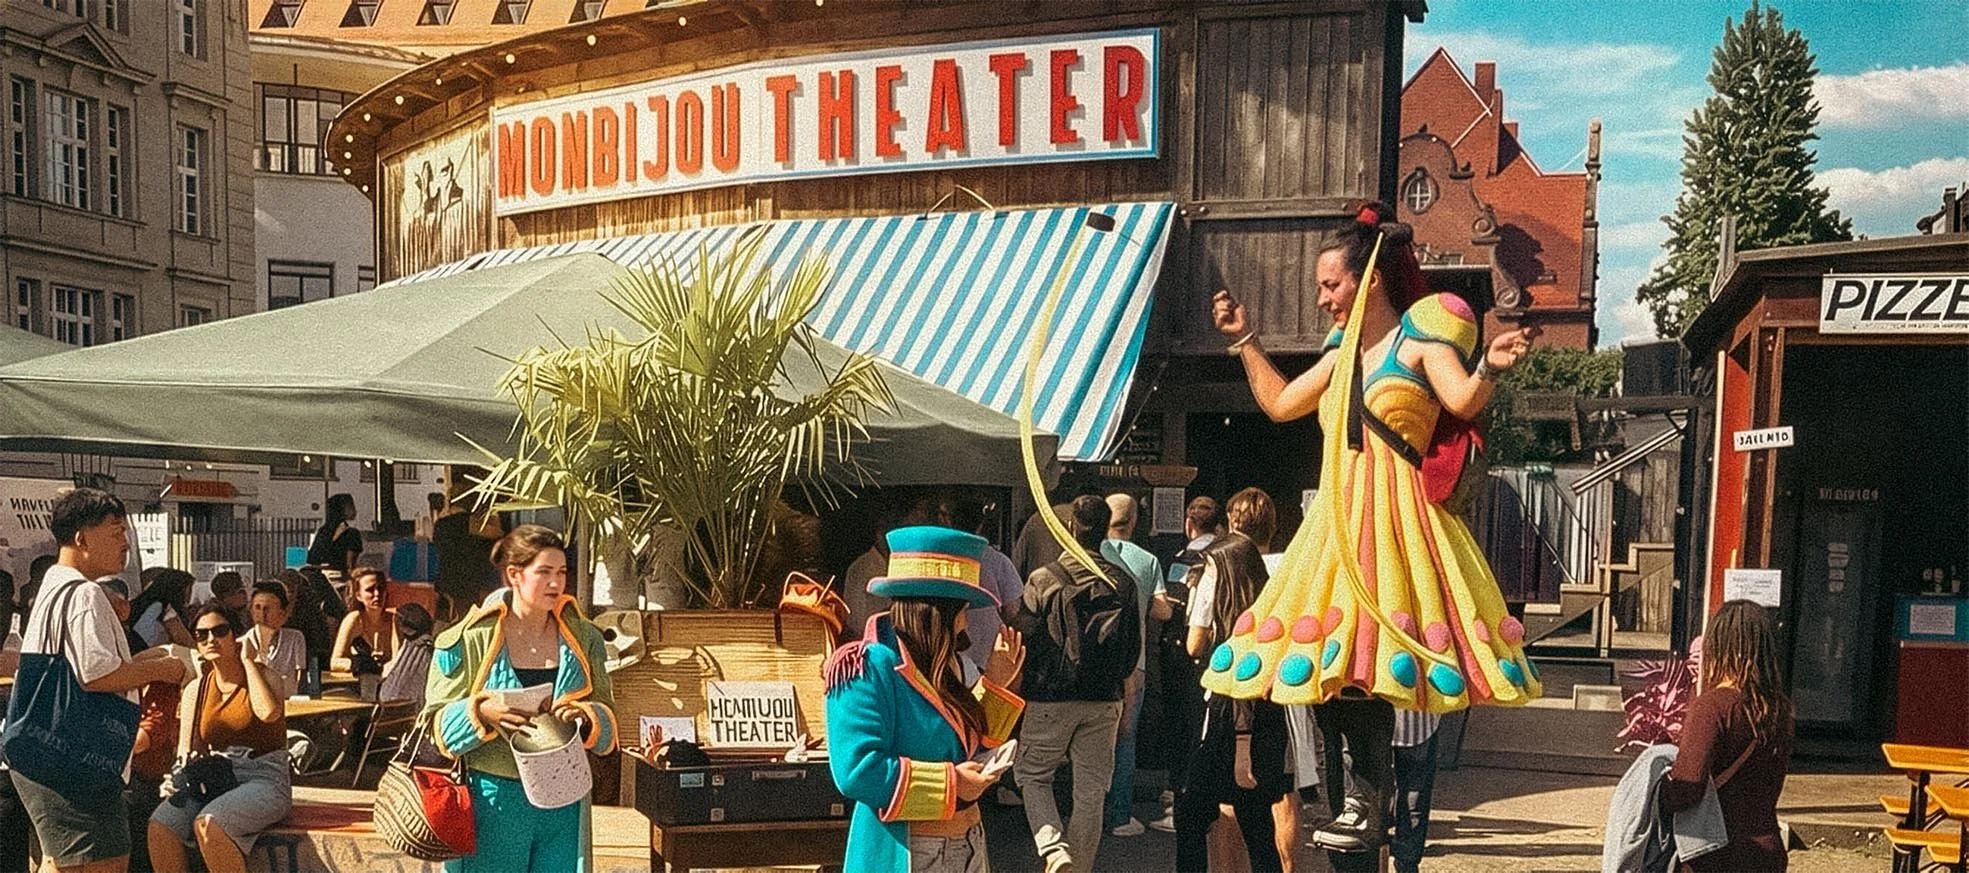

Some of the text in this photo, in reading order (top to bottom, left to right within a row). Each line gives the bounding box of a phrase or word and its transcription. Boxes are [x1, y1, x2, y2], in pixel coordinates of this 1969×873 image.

[497, 45, 1145, 199] MONBIJOU THEATER
[1824, 278, 1969, 321] PIZZE
[711, 720, 796, 742] THEATER
